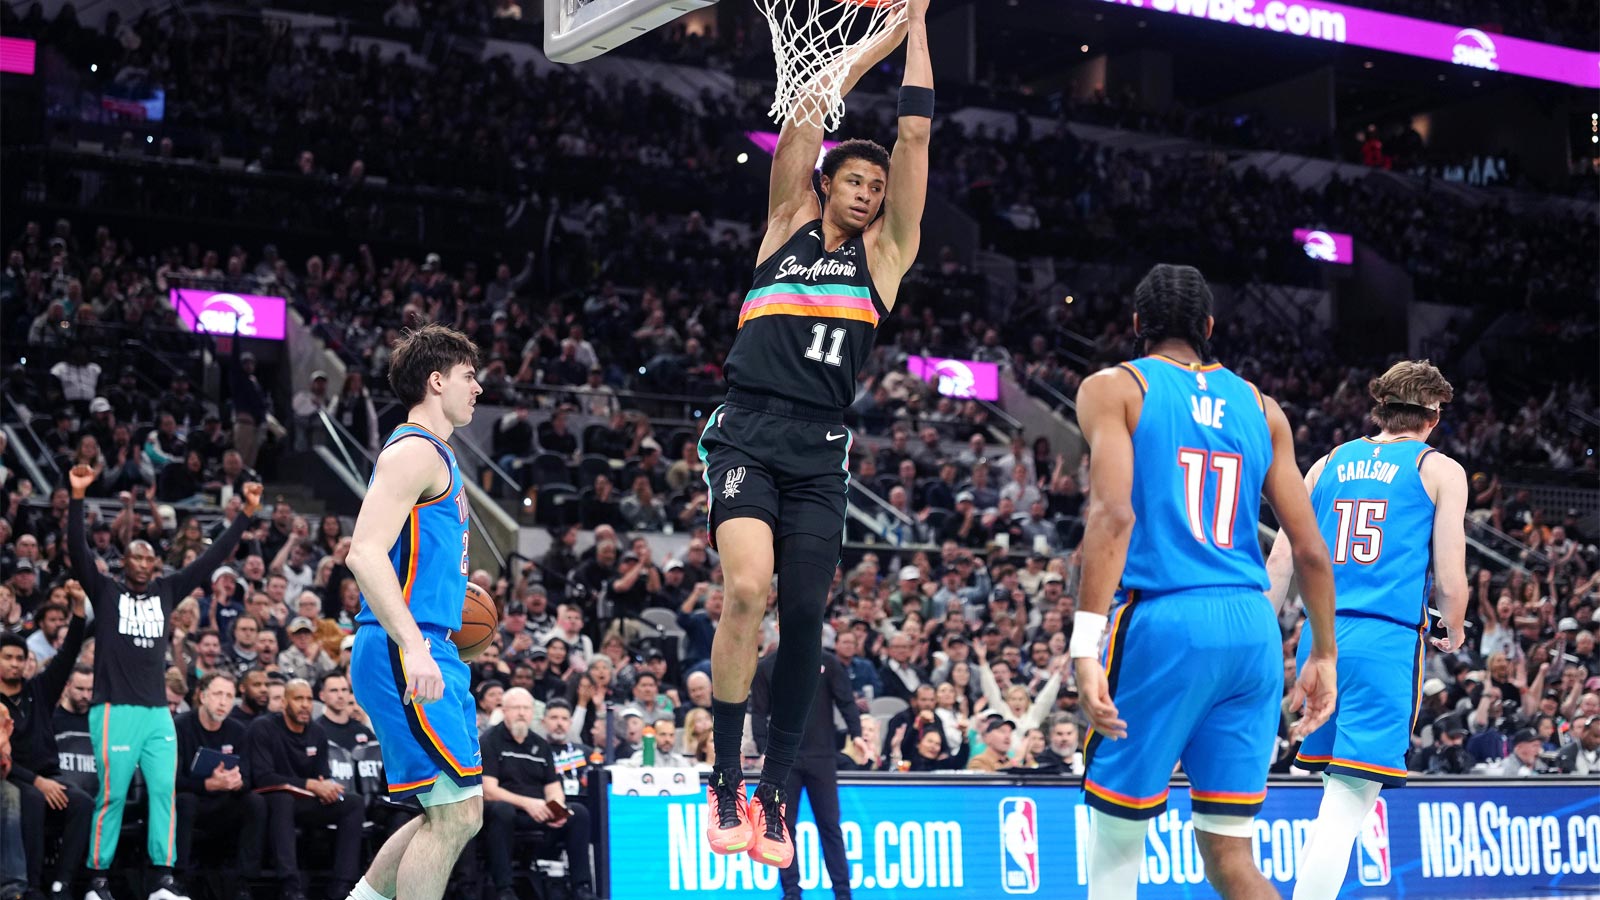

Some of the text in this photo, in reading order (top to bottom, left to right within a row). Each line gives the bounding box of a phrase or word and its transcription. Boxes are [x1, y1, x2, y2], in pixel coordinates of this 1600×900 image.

[804, 322, 847, 367] 11
[1190, 395, 1226, 429] JOE
[1337, 459, 1400, 485] CARLSON
[1178, 447, 1242, 549] 11
[1333, 499, 1388, 565] 15
